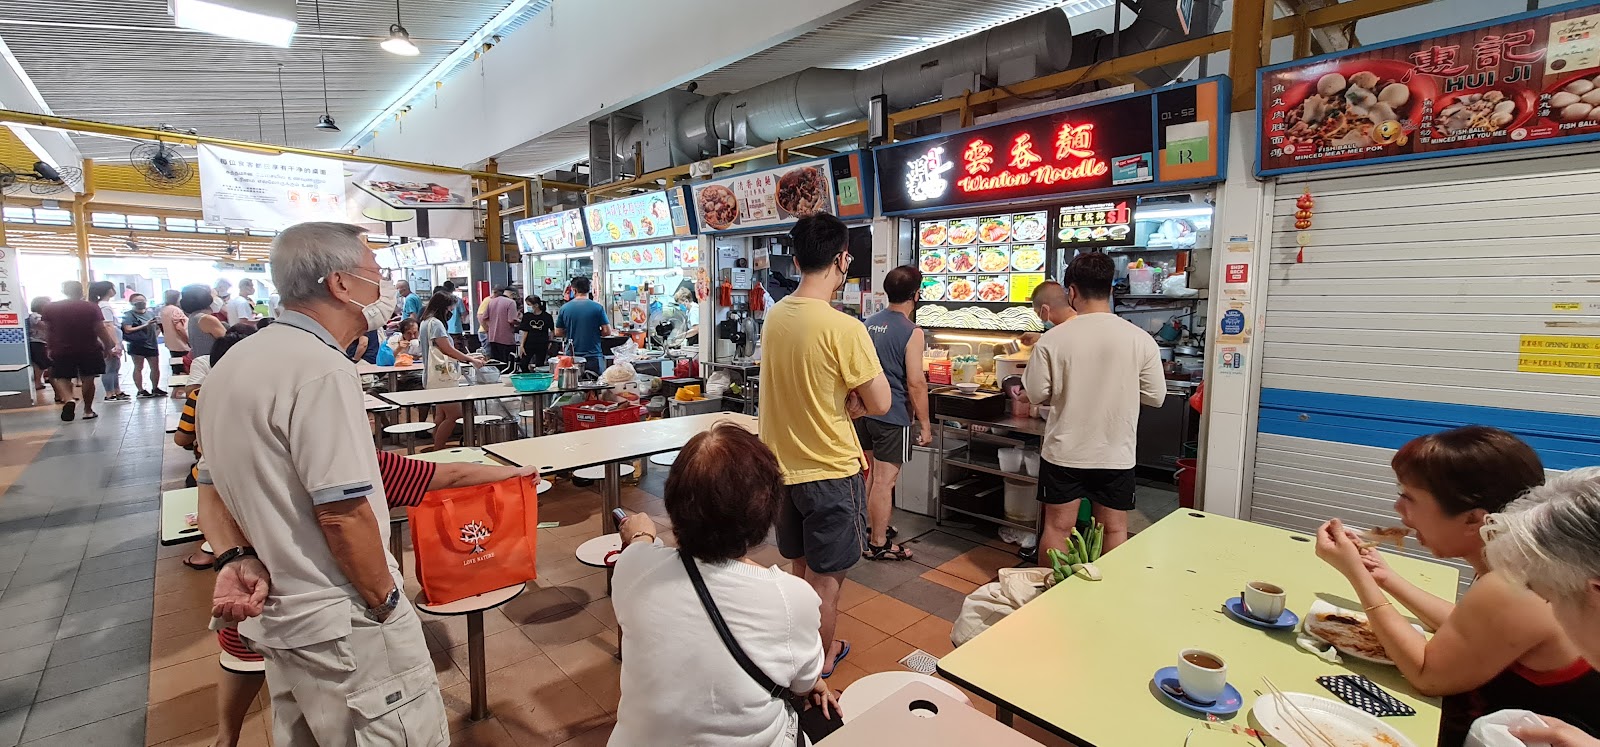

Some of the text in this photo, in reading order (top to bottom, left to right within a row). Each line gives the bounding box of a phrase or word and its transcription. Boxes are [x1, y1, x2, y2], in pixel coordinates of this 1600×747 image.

[1445, 65, 1532, 93] HUI JI
[1559, 120, 1598, 130] FISH BALL
[1318, 145, 1338, 153] FISH
[1295, 152, 1323, 161] MINCED
[1324, 150, 1346, 158] MEAT
[957, 170, 1031, 192] Wanton
[1030, 158, 1108, 185] Noodle
[1544, 341, 1569, 349] OPENING
[463, 552, 495, 566] LOVE NATURE
